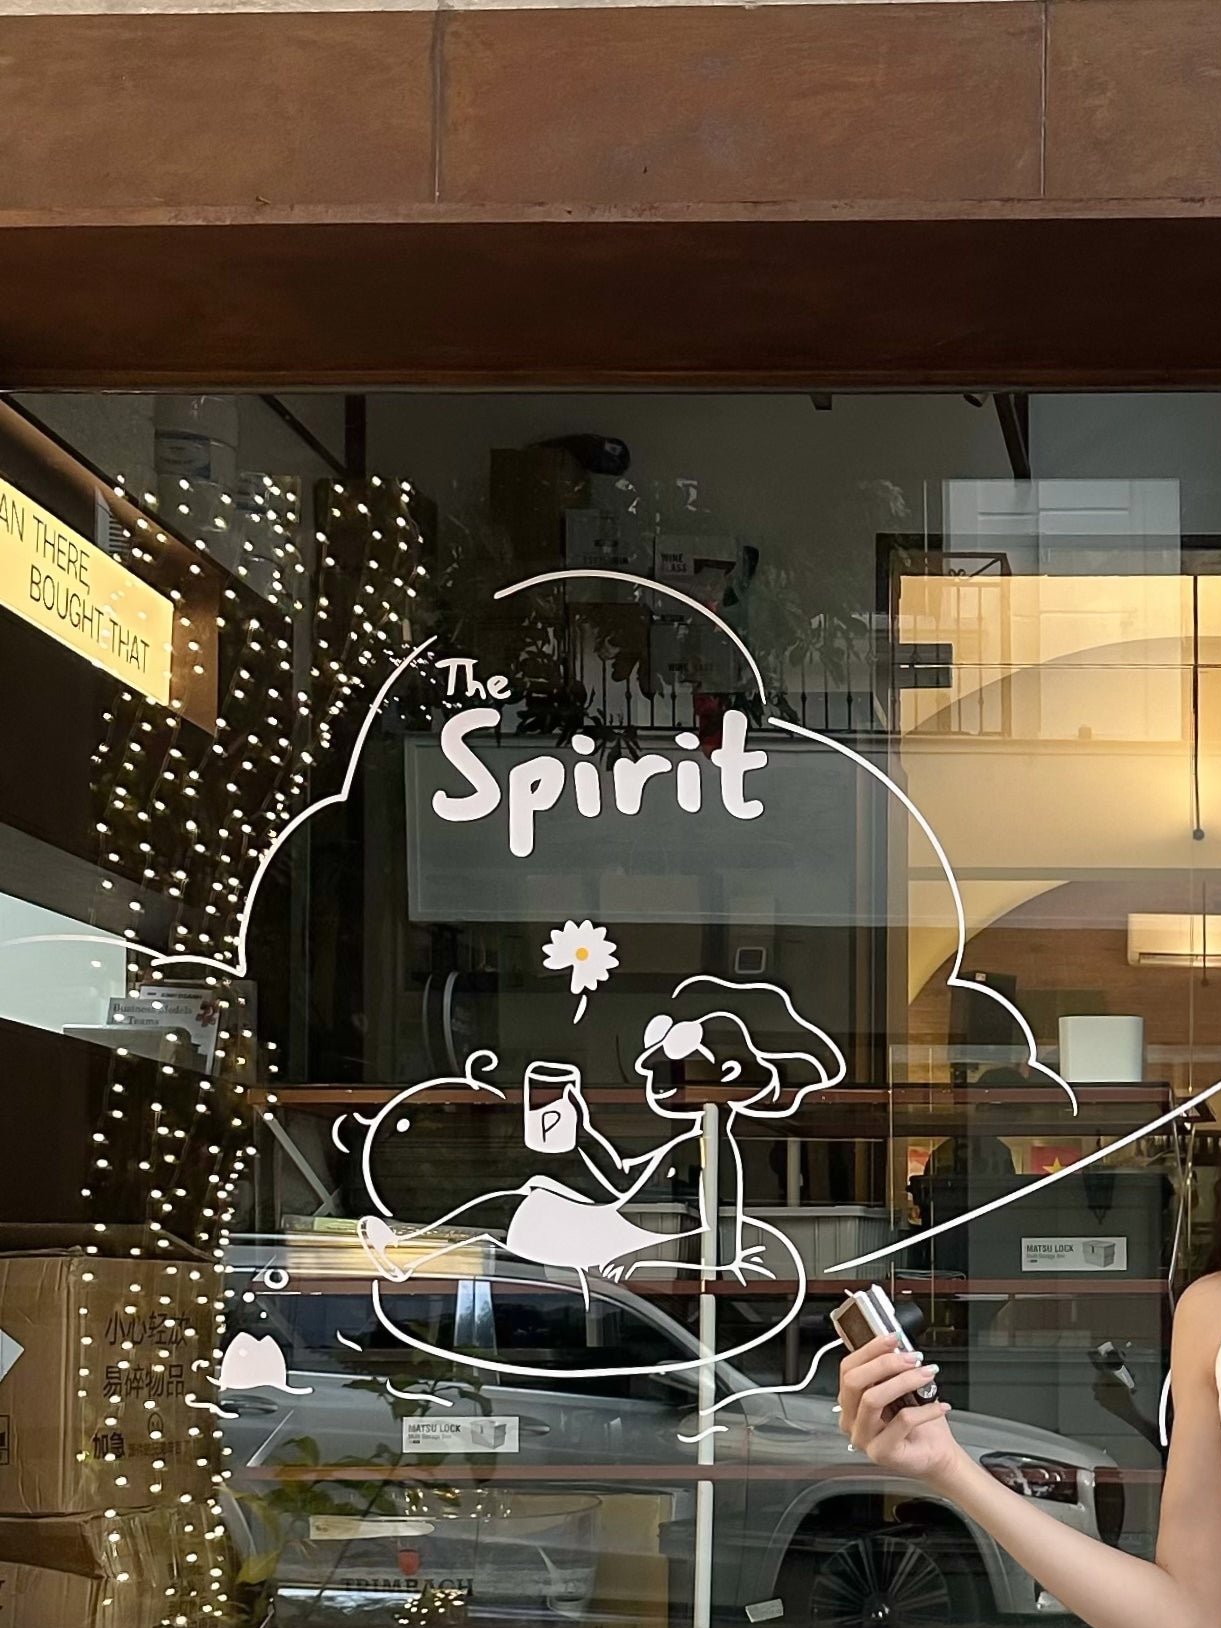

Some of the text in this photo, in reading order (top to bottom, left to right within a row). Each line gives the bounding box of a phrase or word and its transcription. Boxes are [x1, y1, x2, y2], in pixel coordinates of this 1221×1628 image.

[0, 492, 91, 595] AN THERE,
[30, 564, 151, 674] BOUGHT THAT
[435, 657, 511, 700] The
[431, 707, 769, 858] Spirit
[105, 1310, 192, 1347] 小心轻放
[103, 1363, 185, 1400] 易碎物品
[92, 1431, 125, 1460] 加急
[439, 1423, 461, 1433] LOCK
